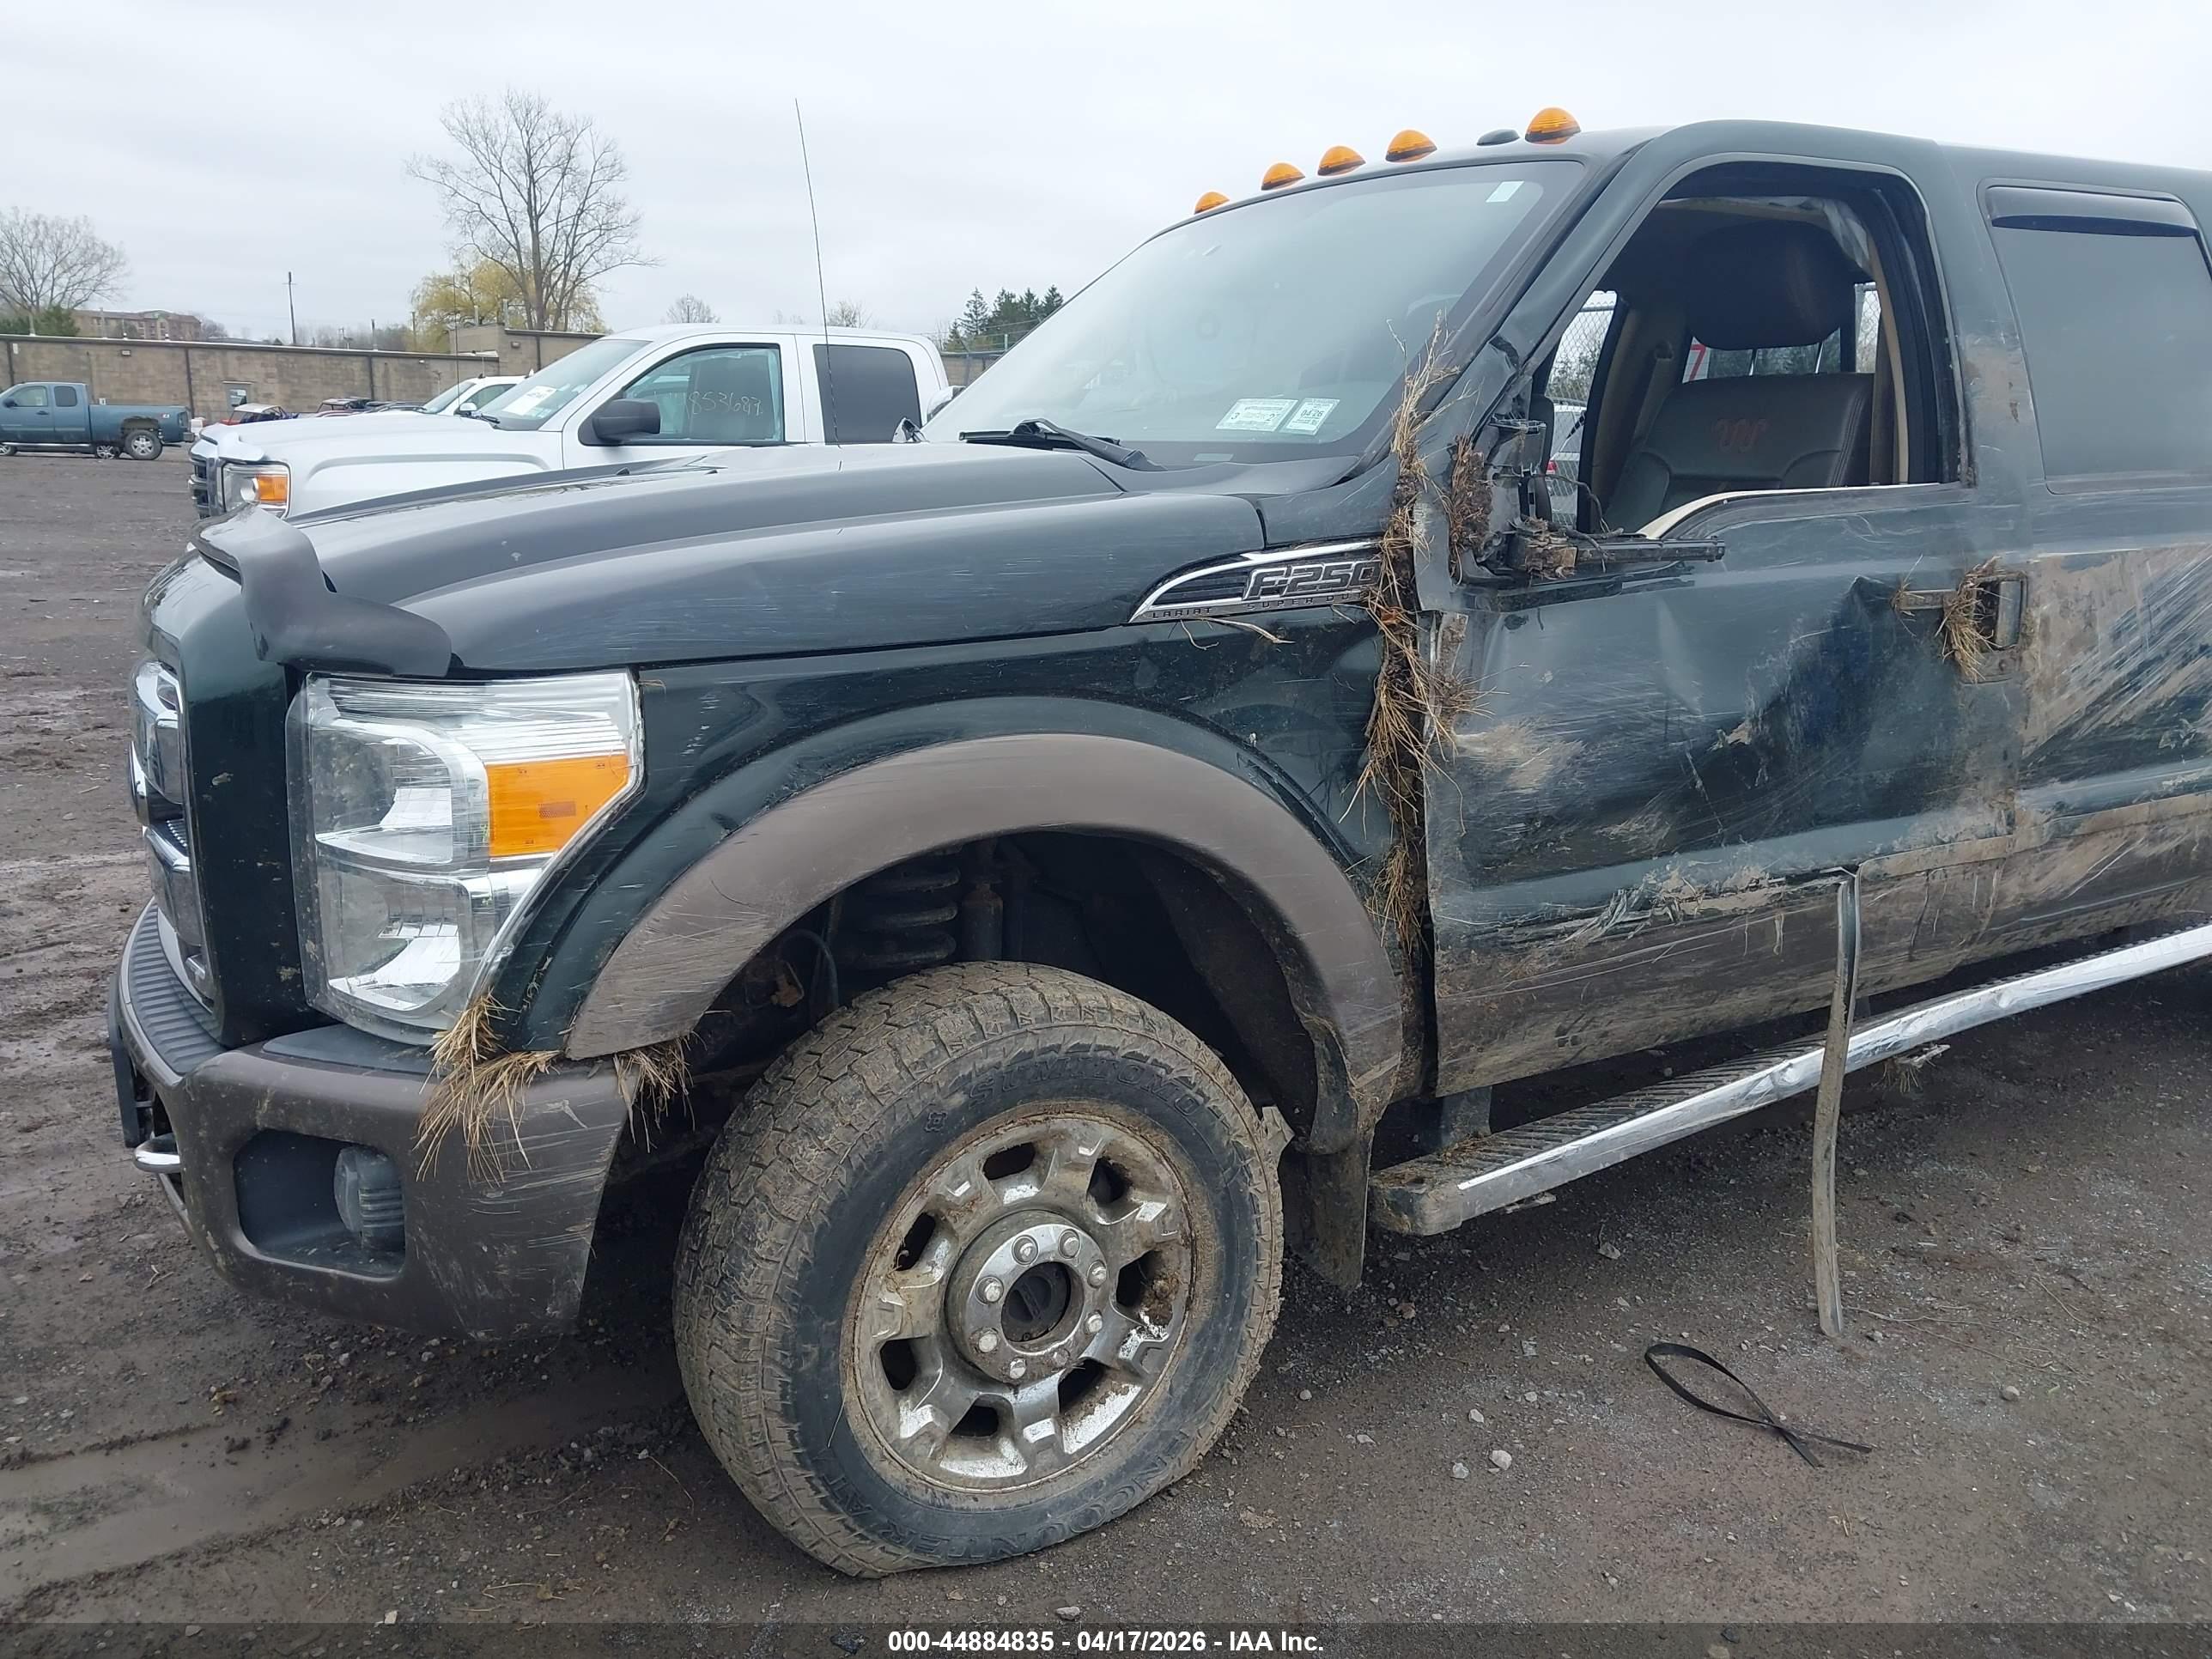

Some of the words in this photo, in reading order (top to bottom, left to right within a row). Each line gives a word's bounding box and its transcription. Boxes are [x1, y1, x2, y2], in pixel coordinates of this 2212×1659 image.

[1243, 560, 1382, 600] F-250
[1152, 607, 1212, 619] LARIAT
[1247, 596, 1314, 611] SUPER
[1326, 592, 1364, 604] DU
[967, 1056, 1202, 1115] SUMITOMO
